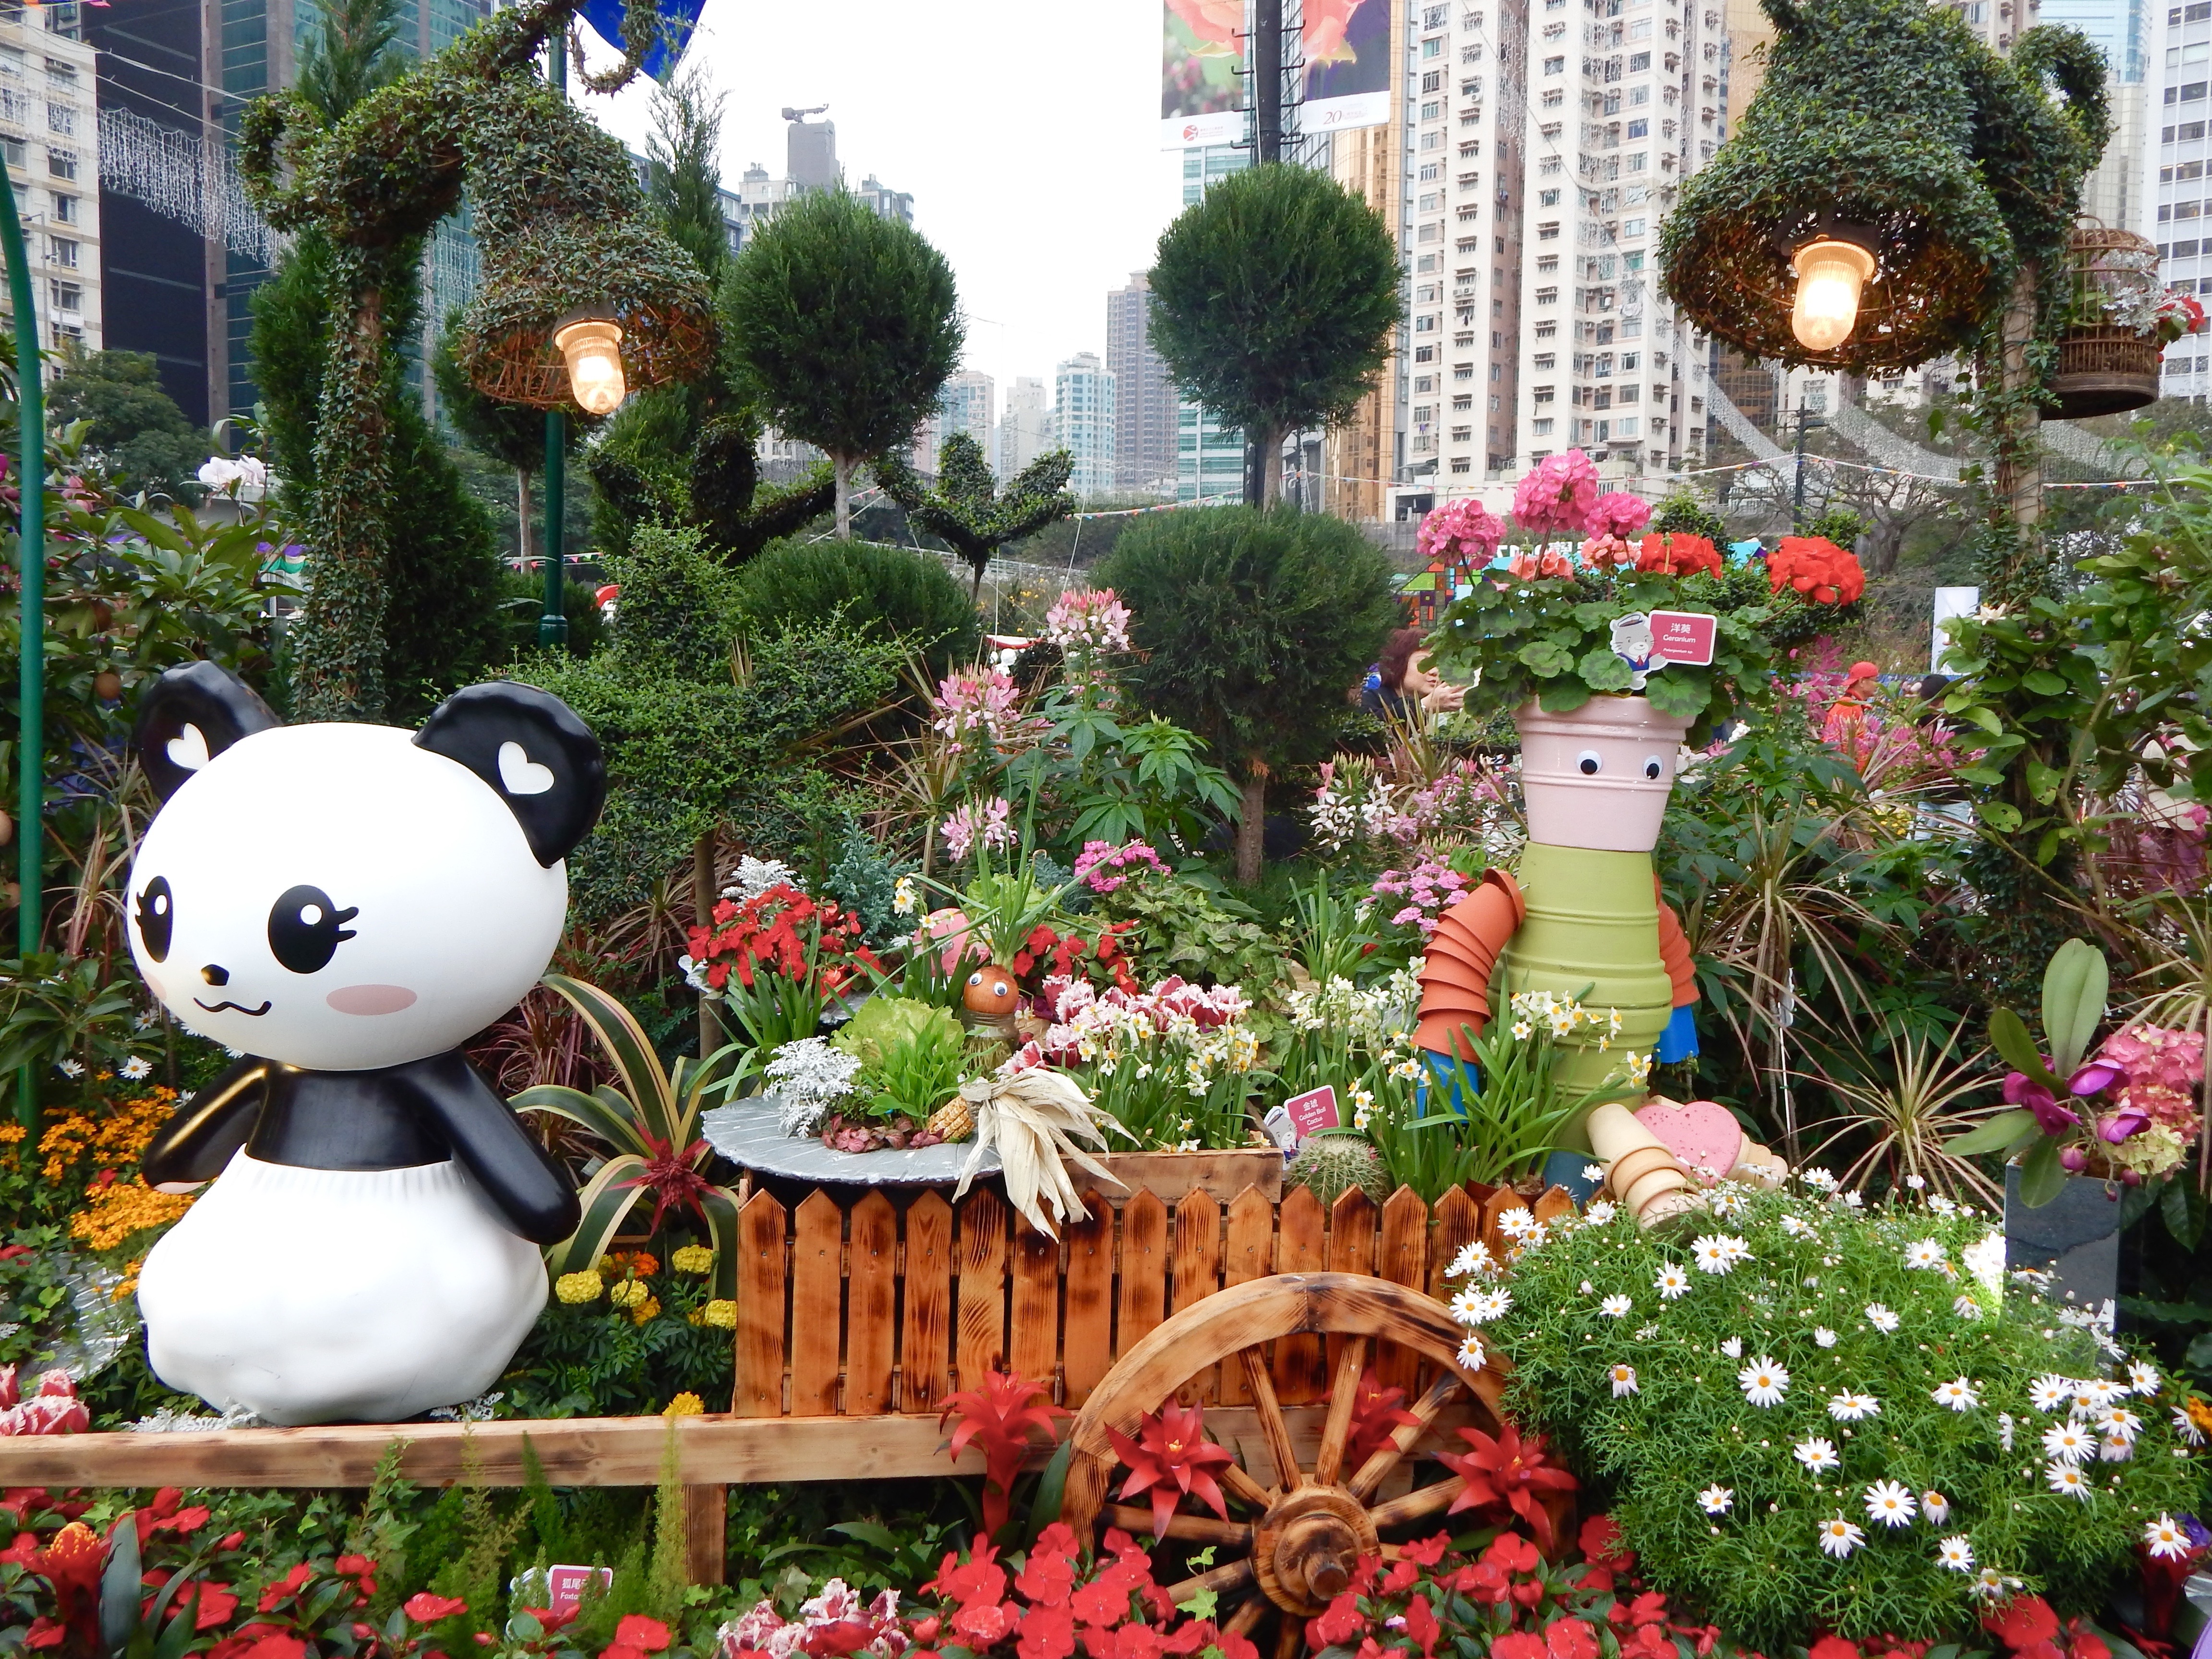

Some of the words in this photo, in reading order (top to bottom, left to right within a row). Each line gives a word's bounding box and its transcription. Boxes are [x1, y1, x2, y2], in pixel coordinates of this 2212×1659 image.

[1323, 110, 1342, 125] 20
[1663, 634, 1696, 643] Geranium
[1299, 1111, 1316, 1121] Golden
[1316, 1106, 1326, 1114] Ball
[1307, 1116, 1323, 1126] Cactus
[560, 1592, 578, 1600] Foxta
